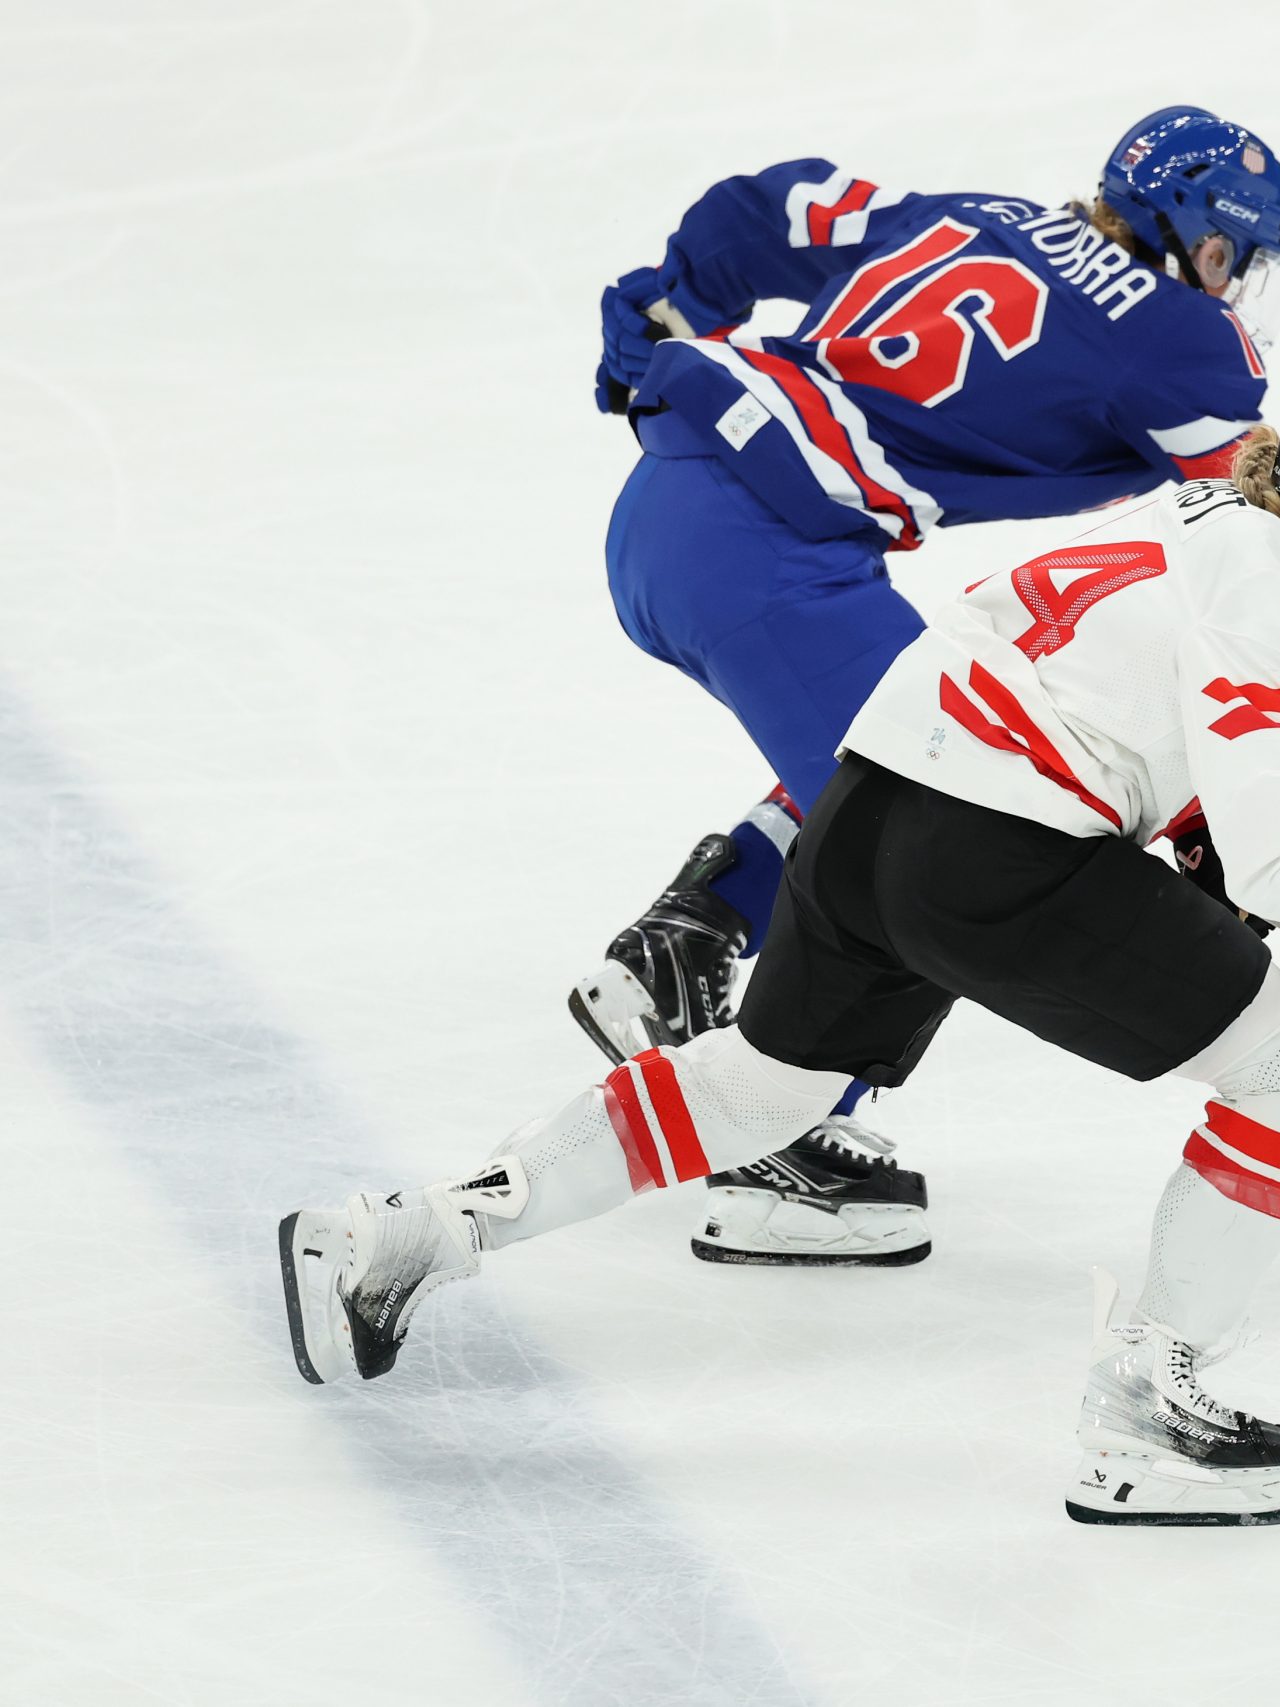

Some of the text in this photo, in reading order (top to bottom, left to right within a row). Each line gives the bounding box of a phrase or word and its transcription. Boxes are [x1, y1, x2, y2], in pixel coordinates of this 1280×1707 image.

[1215, 199, 1260, 224] CCM
[800, 215, 1050, 409] 16
[965, 535, 1168, 664] 4
[697, 975, 717, 1029] CCM
